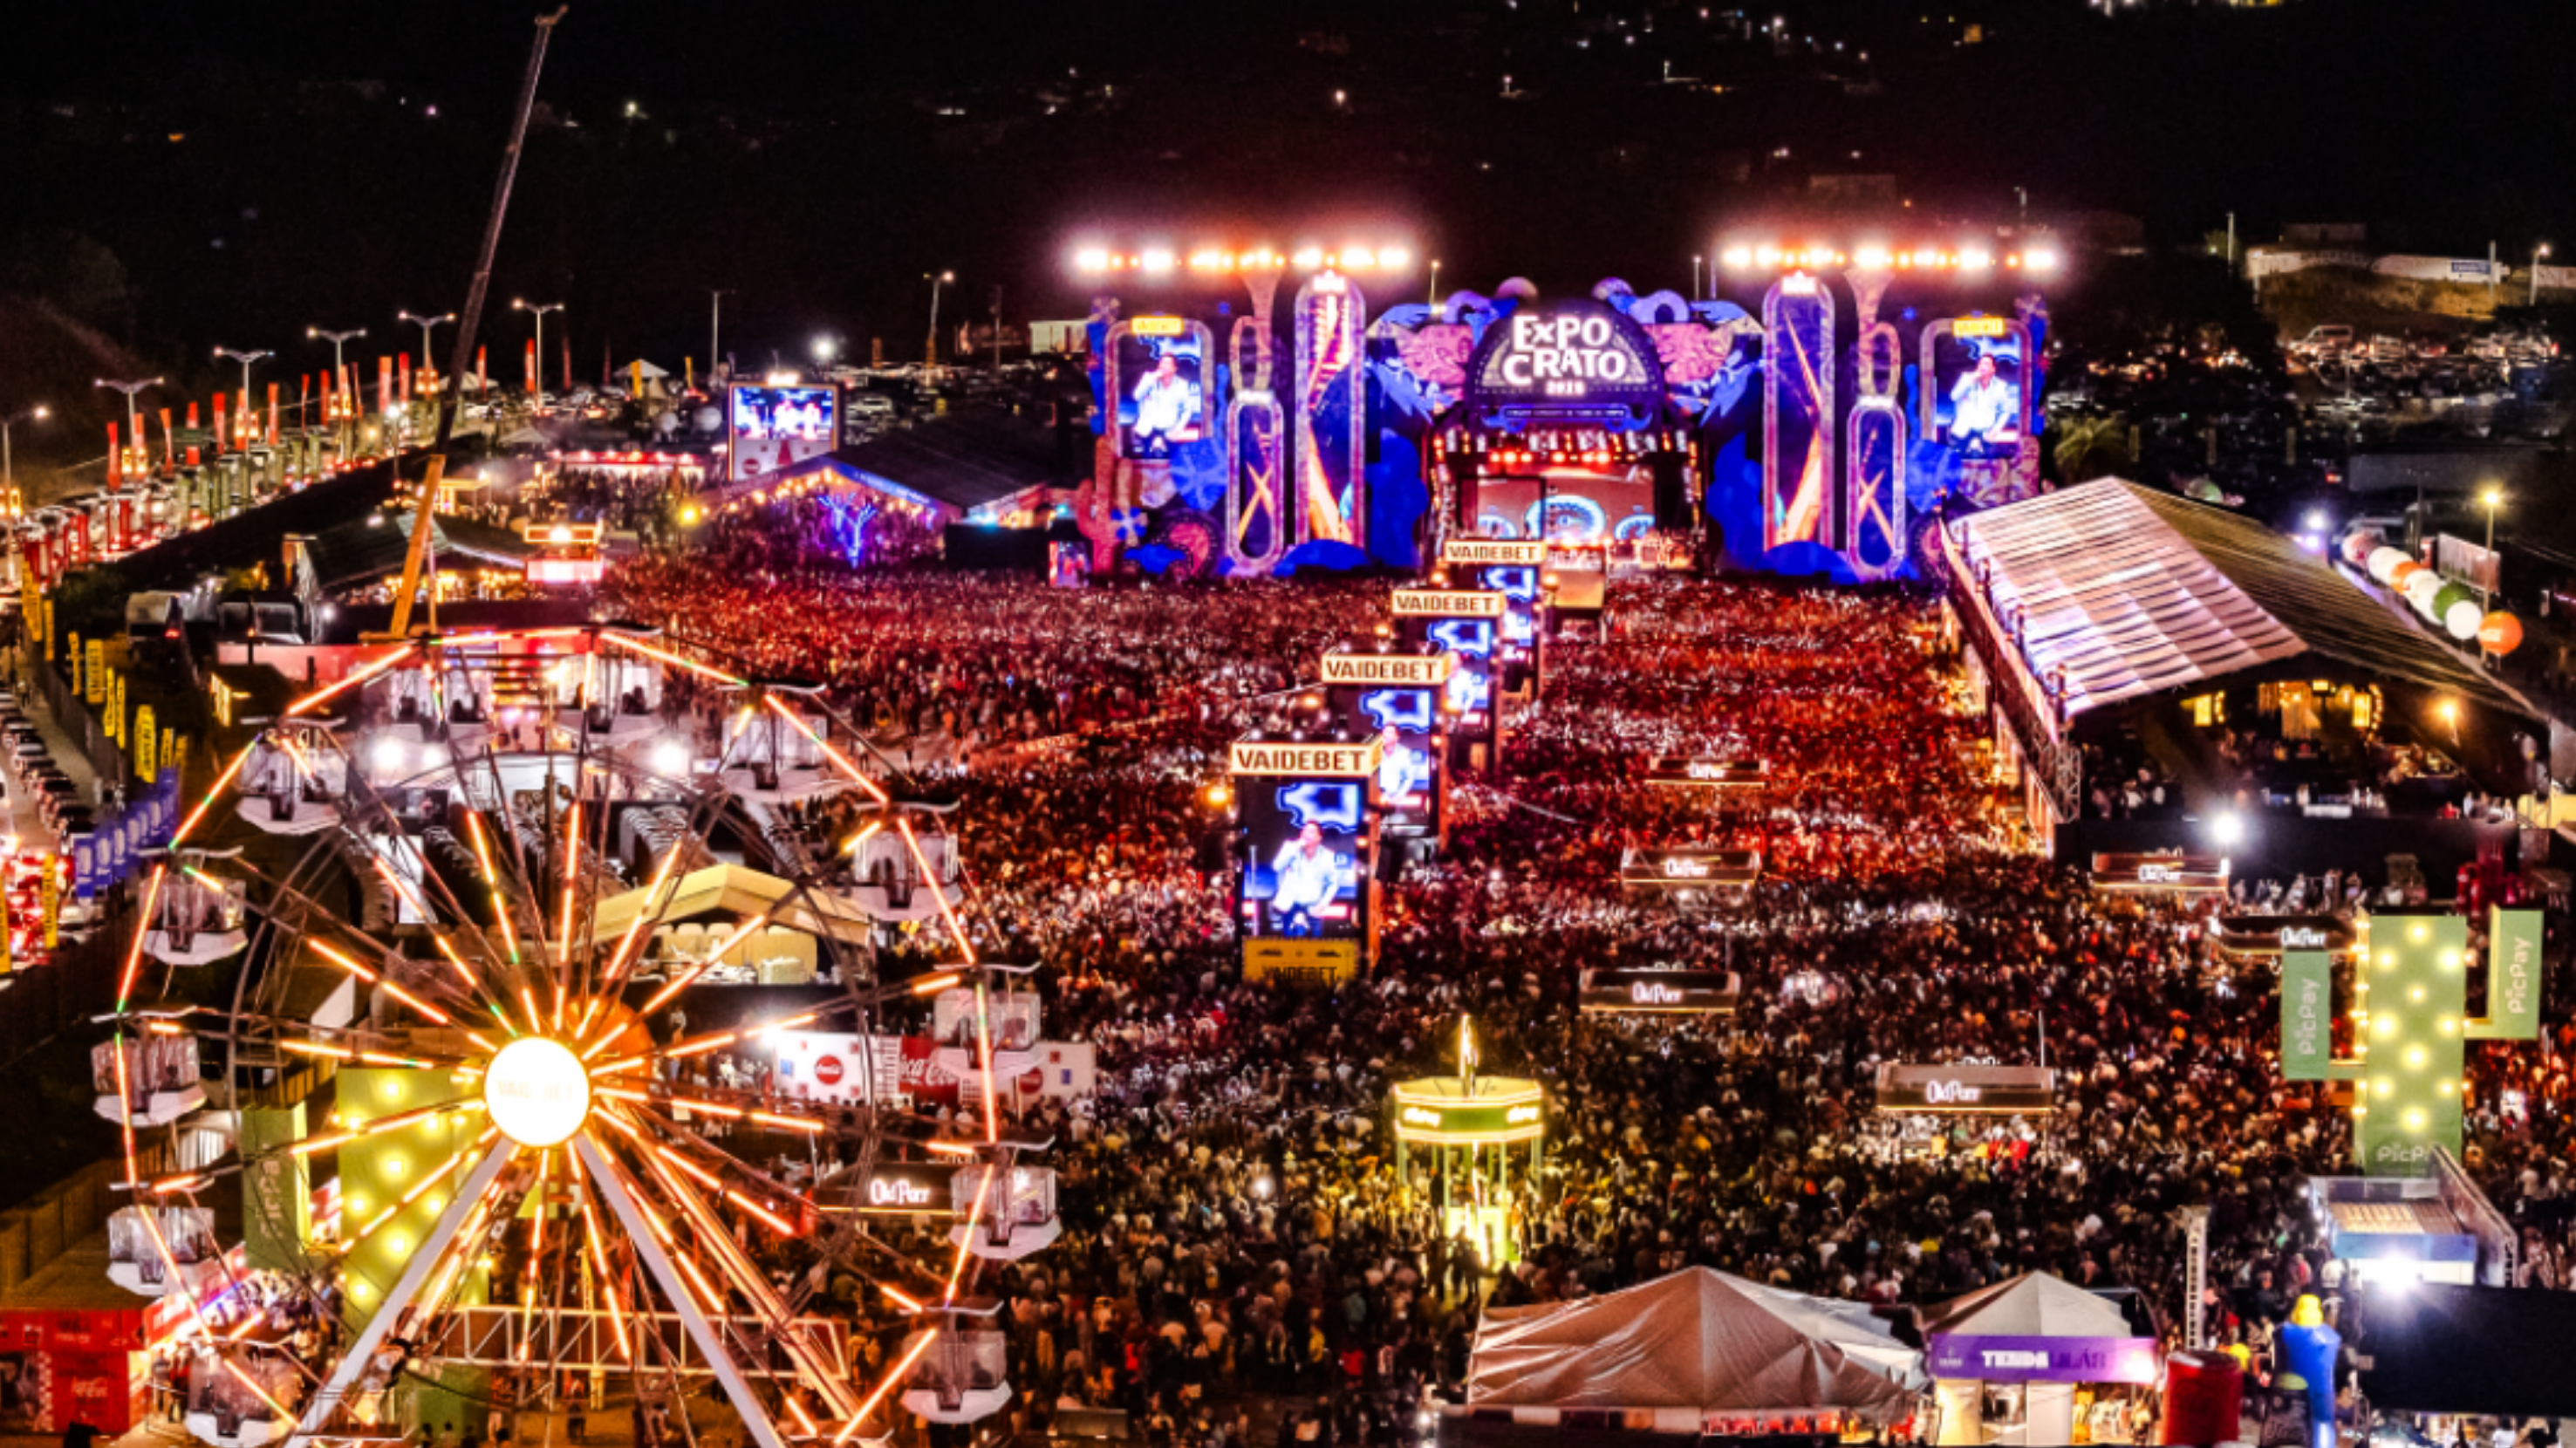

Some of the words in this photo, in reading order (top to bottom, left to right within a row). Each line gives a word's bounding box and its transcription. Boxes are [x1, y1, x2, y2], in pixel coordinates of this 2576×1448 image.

[1503, 347, 1627, 386] CRATO
[1448, 546, 1536, 559] VAIDEBET
[1396, 595, 1494, 611] VAIDEBET
[1326, 659, 1438, 679] VAIDEBET
[1237, 748, 1366, 771] VAIDEBET
[2504, 935, 2533, 1014] PicPay
[2293, 977, 2321, 1055] PicPay
[1926, 1080, 1951, 1103] Old
[1951, 1081, 1982, 1103] Parr
[870, 1178, 896, 1205] Old
[895, 1178, 931, 1205] Parr
